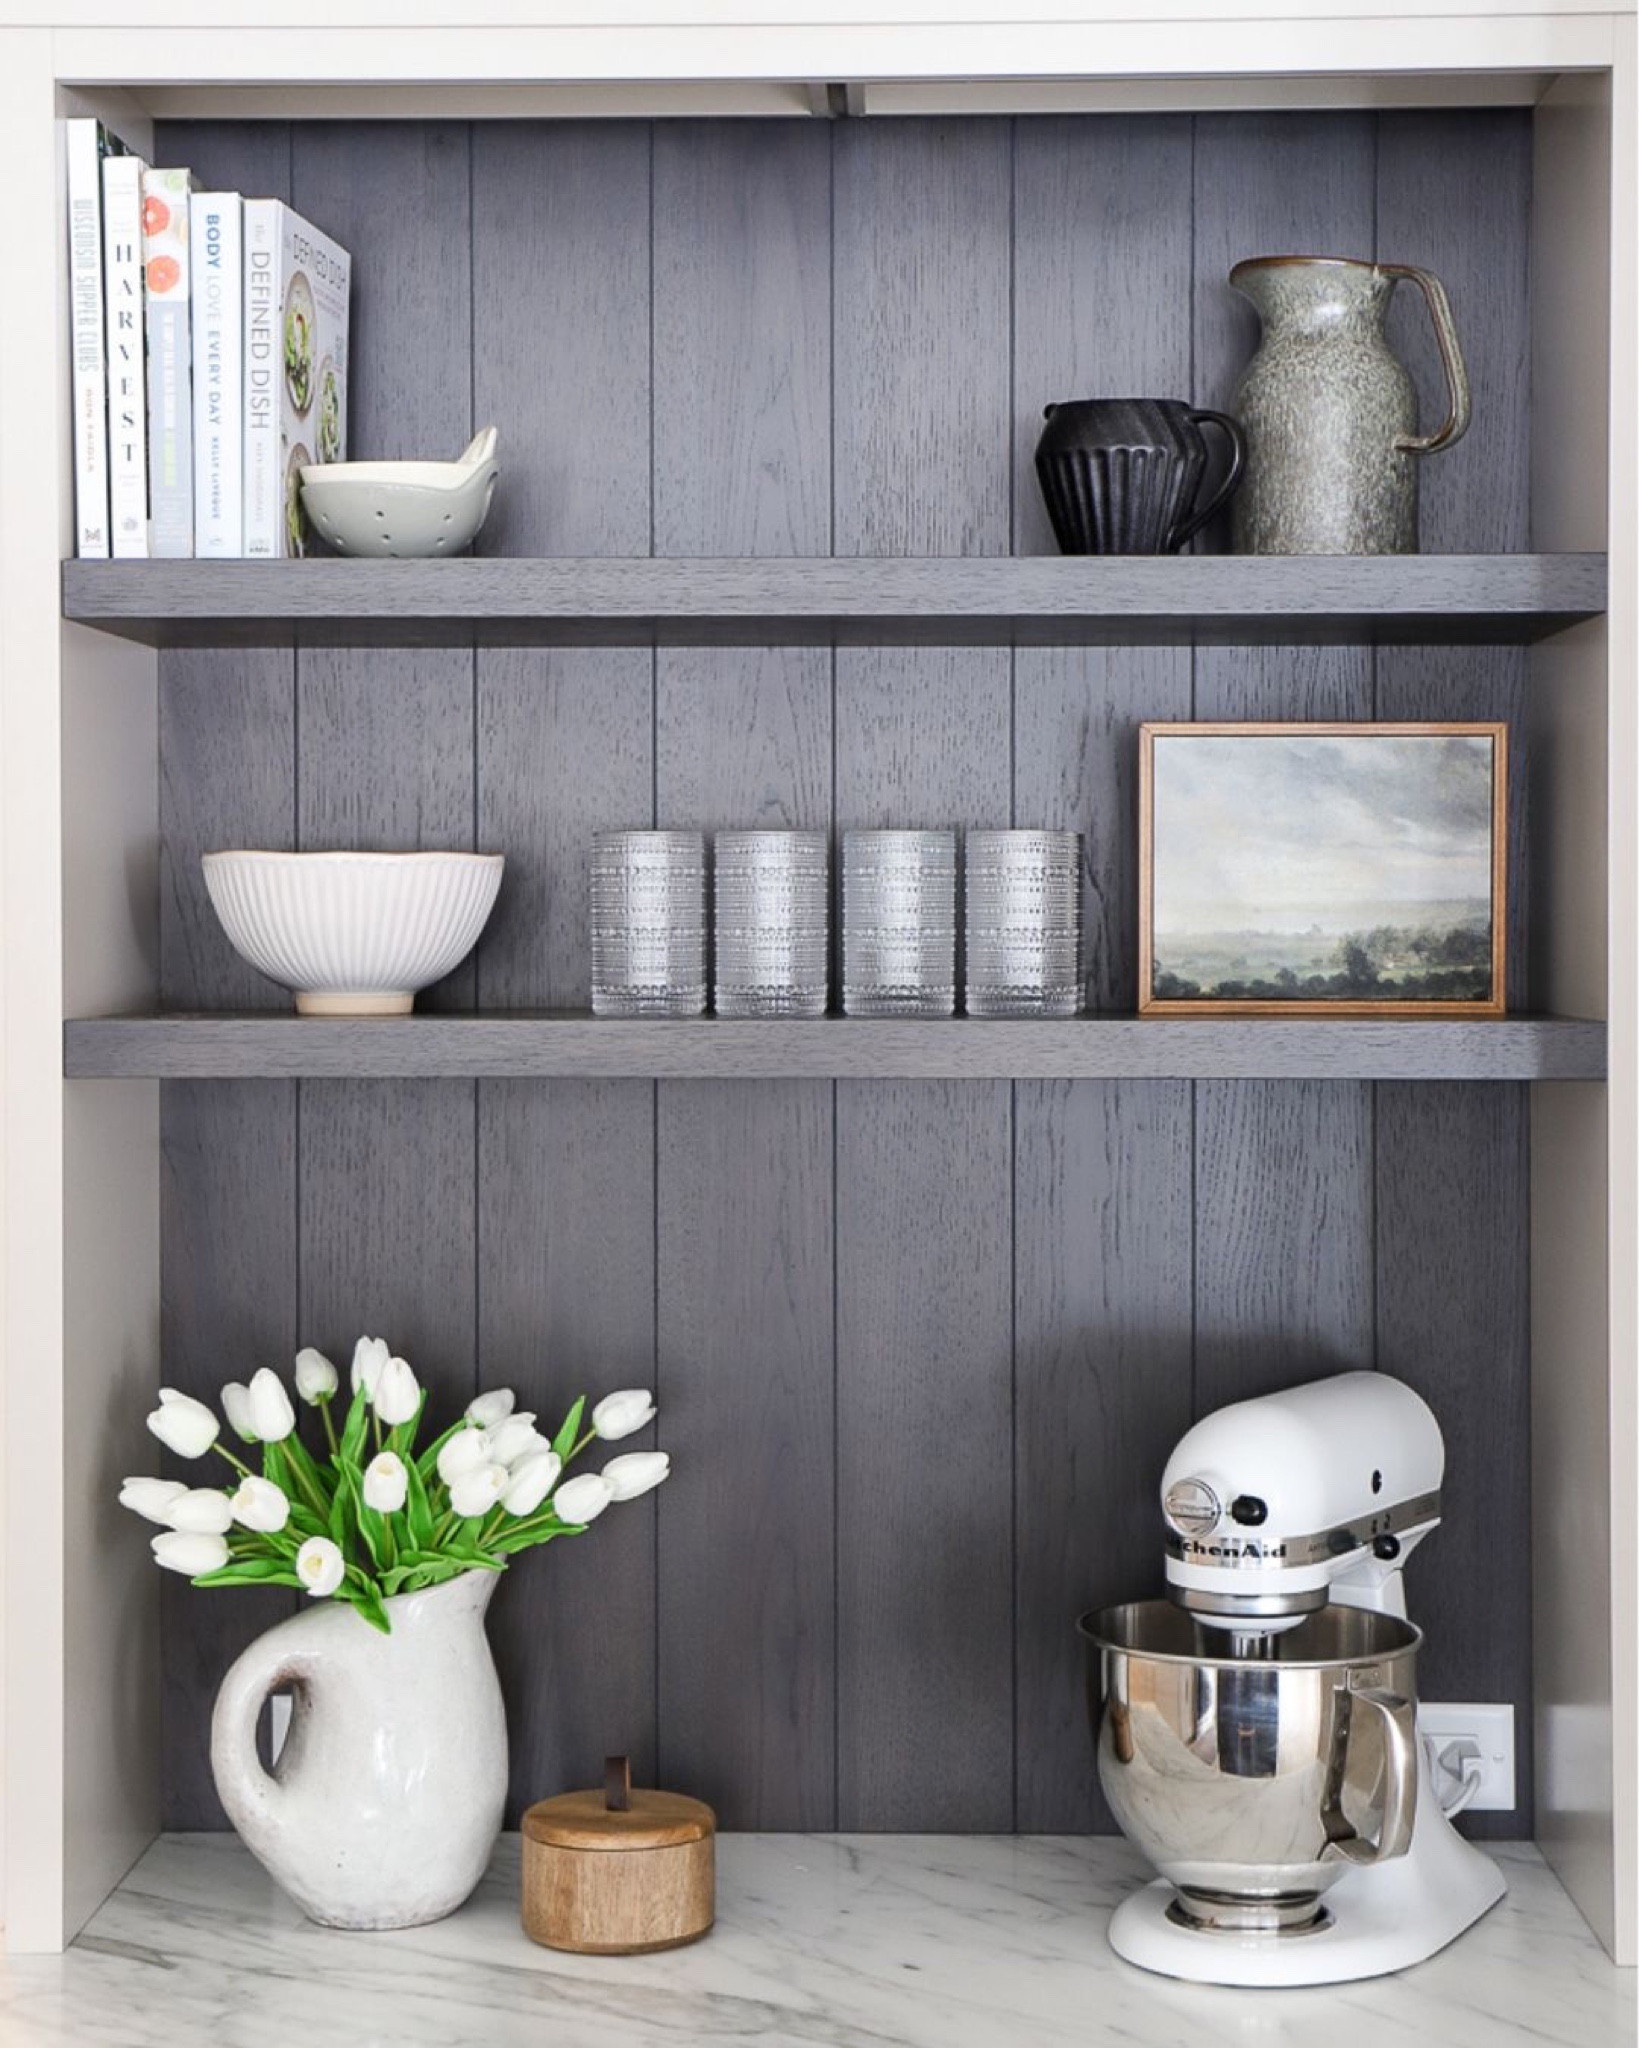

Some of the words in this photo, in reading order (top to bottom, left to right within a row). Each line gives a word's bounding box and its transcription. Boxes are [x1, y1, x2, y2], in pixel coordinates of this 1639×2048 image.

[206, 214, 220, 268] BODY
[76, 275, 98, 327] SUPPER
[206, 275, 221, 318] LOVE
[251, 252, 270, 360] DEFINED
[77, 332, 99, 373] CLUBS
[116, 244, 137, 462] HARVEST
[208, 330, 221, 385] EVERY
[208, 392, 221, 425] DAY
[250, 369, 270, 429] DISH
